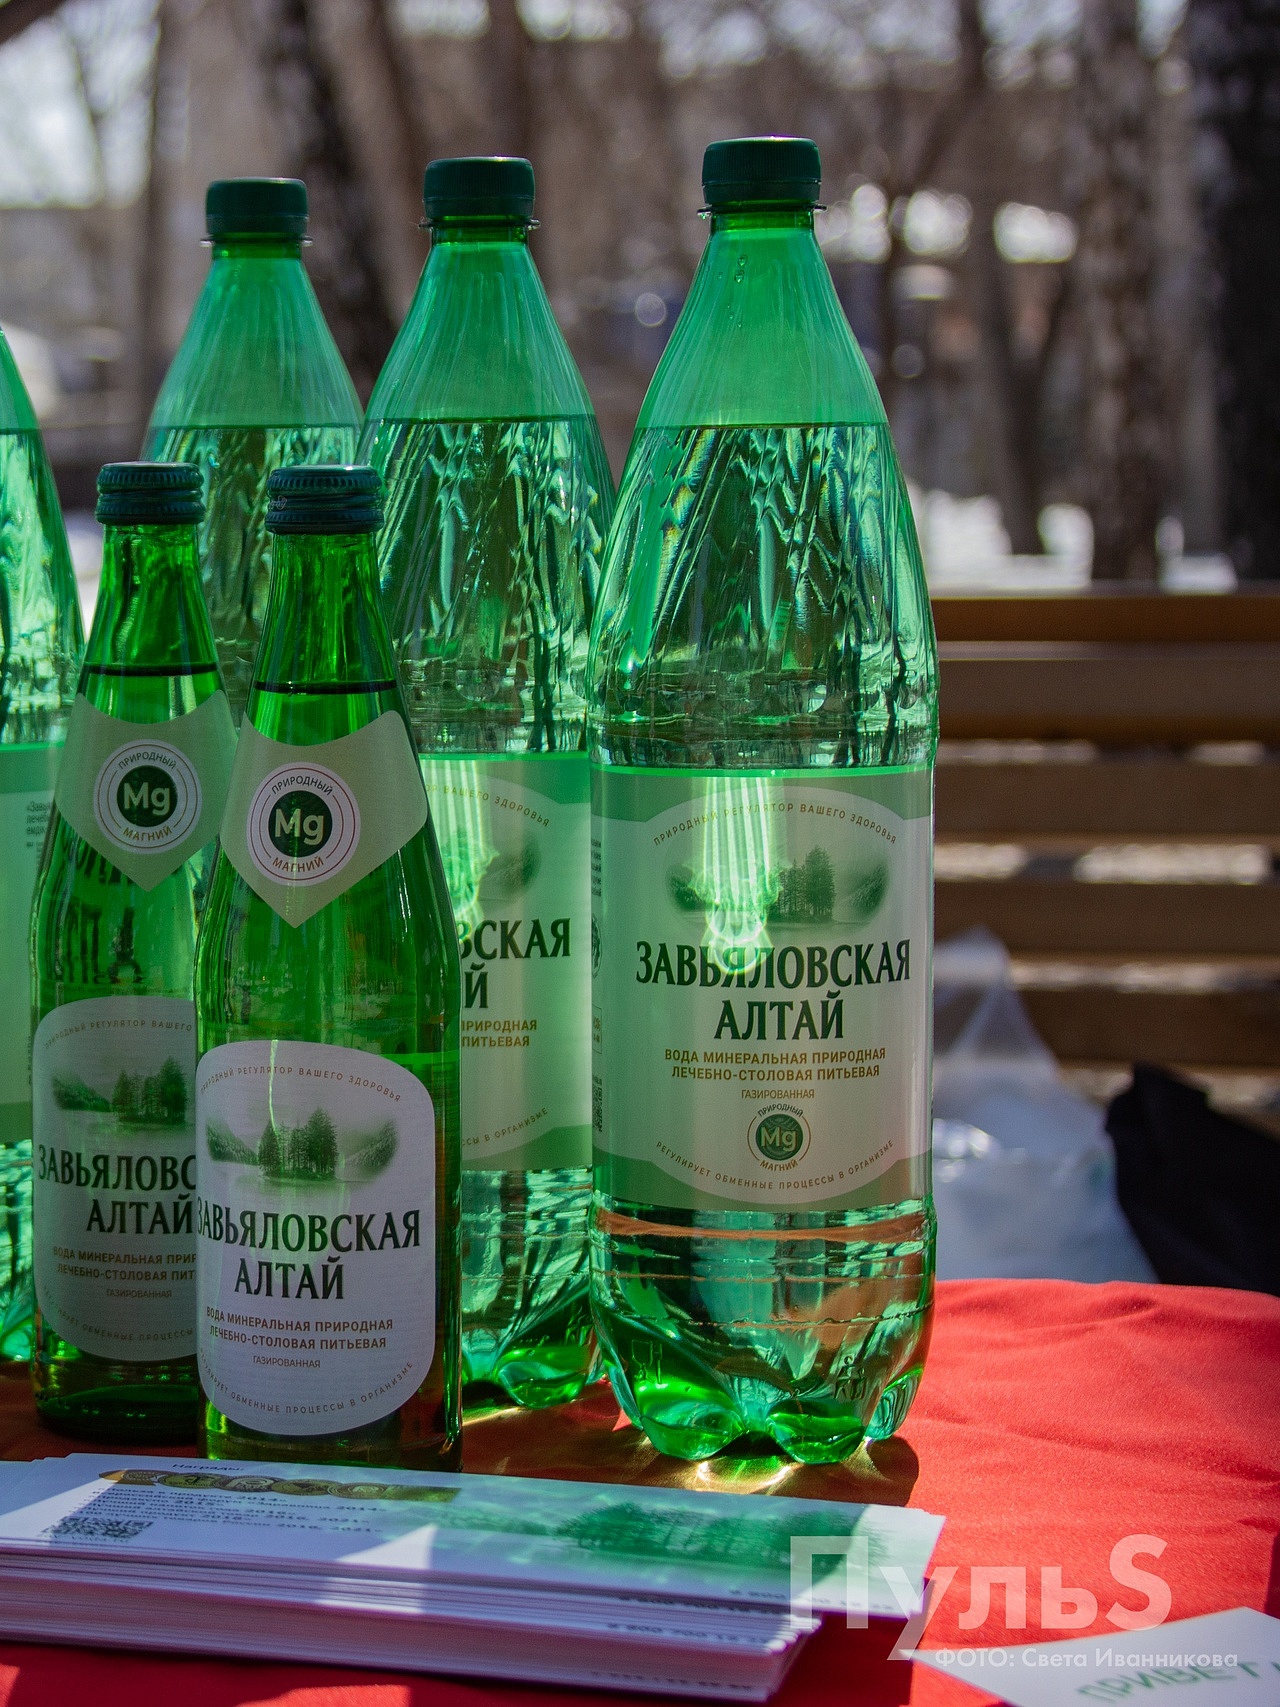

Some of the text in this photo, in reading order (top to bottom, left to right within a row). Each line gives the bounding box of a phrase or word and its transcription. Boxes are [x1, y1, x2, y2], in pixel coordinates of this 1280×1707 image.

[117, 751, 177, 770] ПРИРОДНЫЙ
[271, 775, 333, 796] ПРИРОДНЫЙ
[123, 781, 170, 816] Mg
[494, 796, 550, 827] ЗДОРОВЬЯ
[122, 825, 173, 841] МАГНИЙ
[274, 808, 325, 846] Mg
[653, 811, 718, 847] ПРИРОДНЫЙ
[800, 802, 846, 819] ВАШЕГО
[849, 812, 898, 845] ЗДОРОВЬЯ
[272, 856, 325, 873] МАГНИЙ
[636, 938, 911, 989] ЗАВЬЯЛОВСКАЯ
[90, 1019, 146, 1030] РЕГУЛЯТОР
[151, 1019, 193, 1032] ВАШЕГО
[713, 989, 844, 1040] АЛТАЙ
[461, 1035, 531, 1048] ПИТЬЕВАЯ
[664, 1048, 886, 1066] ВОДА МИНЕРАЛЬНАЯ ПРИРОДНАЯ
[238, 1066, 293, 1076] РЕГУЛЯТОР
[298, 1067, 344, 1081] ВАШЕГО
[348, 1075, 401, 1102] ЗДОРОВЬЯ
[671, 1064, 880, 1081] ЛЕЧЕБНО-СТОЛОВАЯ ПИТЬЕВАЯ
[741, 1088, 815, 1100] ГАЗИРОВАННАЯ
[757, 1103, 803, 1118] ПРИРОДНЫЙ
[484, 1134, 491, 1143] В
[495, 1107, 549, 1139] ОРГАНИЗМЕ
[760, 1126, 798, 1151] Mg
[38, 1144, 196, 1192] ЗАВЬЯЛОВС
[656, 1139, 895, 1190] РЕГУЛИРУЕТ ОБМЕННЫЕ ПРОЦЕССЫ В ОРГАНИЗМЕ
[760, 1158, 798, 1172] МАГНИЙ
[86, 1192, 194, 1235] АЛТАЙ
[197, 1196, 420, 1252] ЗАВЬЯЛОВСКАЯ
[53, 1246, 197, 1265] ВОДА МИНЕРАЛЬНАЯ ПРИР
[57, 1263, 196, 1281] ЛЕЧЕБНО-СТОЛОВАЯ ПИТ
[234, 1255, 344, 1300] АЛТАЙ
[107, 1288, 173, 1299] ГАЗИРОВАННАЯ
[206, 1306, 393, 1334] ВОДА МИНЕРАЛЬНАЯ ПРИРОДНАЯ
[210, 1325, 387, 1350] ЛЕЧЕБНО-СТОЛОВАЯ ПИТЬЕВАЯ
[253, 1355, 320, 1368] ГАЗИРОВАННАЯ
[231, 1391, 280, 1413] ОБМЕННЫЕ
[285, 1402, 344, 1414] ПРОЦЕССЫ
[349, 1398, 356, 1408] В
[360, 1361, 413, 1403] ОРГАНИЗМЕ
